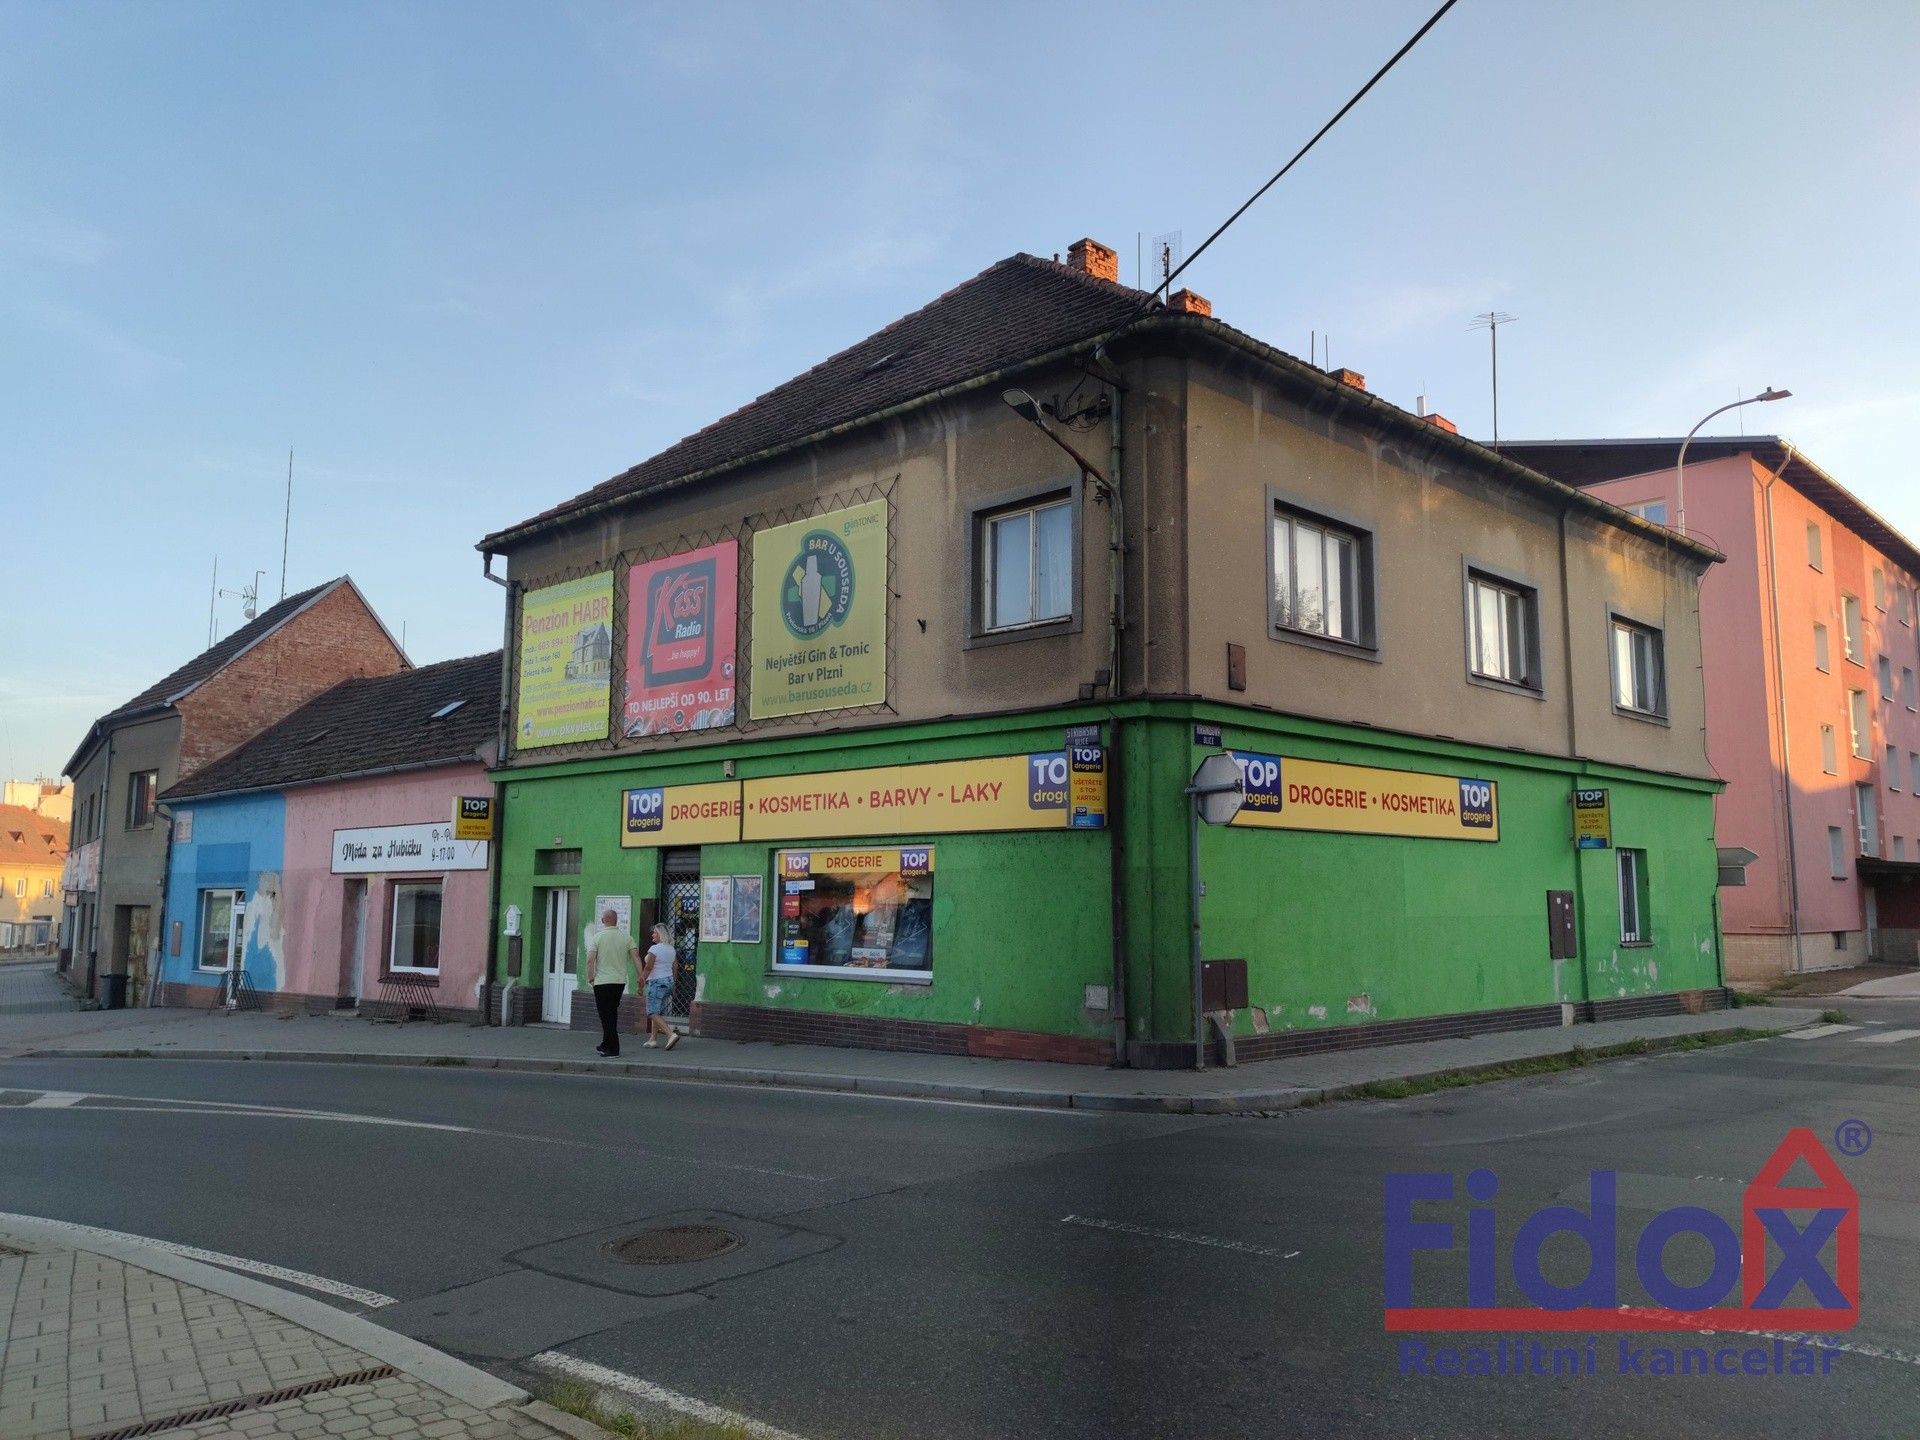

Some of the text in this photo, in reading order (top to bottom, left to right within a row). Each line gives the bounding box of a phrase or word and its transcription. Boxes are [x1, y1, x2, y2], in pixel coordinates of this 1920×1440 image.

[809, 539, 849, 613] BAR U SOUSEDA
[526, 596, 608, 633] Penzion HABR
[647, 572, 704, 657] Kiss
[675, 621, 702, 639] Radio
[766, 642, 869, 671] Největší Gin & Tonic
[789, 665, 843, 685] Bar v Plzni
[629, 688, 730, 714] TO NEJLEPŠÍ OD 90. LET
[762, 681, 872, 706] www.barusouseda.cz
[1074, 748, 1101, 761] TOP
[1033, 758, 1068, 785] TO
[1235, 758, 1278, 787] TOP
[464, 800, 488, 810] TOP
[630, 793, 662, 814] TOP
[671, 800, 741, 821] DROGERIE
[759, 791, 850, 814] KOSMETIKA
[870, 787, 931, 808] BARVY
[950, 782, 1002, 803] LAKY
[1033, 789, 1068, 804] drog
[1245, 792, 1279, 806] rogerie
[1288, 784, 1456, 816] DROGERIE KOSMETIKA
[1461, 784, 1490, 807] TOP
[1578, 791, 1603, 801] TOP
[629, 815, 661, 829] drogerie
[1462, 810, 1491, 823] drogerie
[342, 839, 422, 862] Móda za Hubičku
[902, 853, 927, 867] TOP
[788, 856, 809, 869] TOP
[826, 856, 882, 868] DROGERIE
